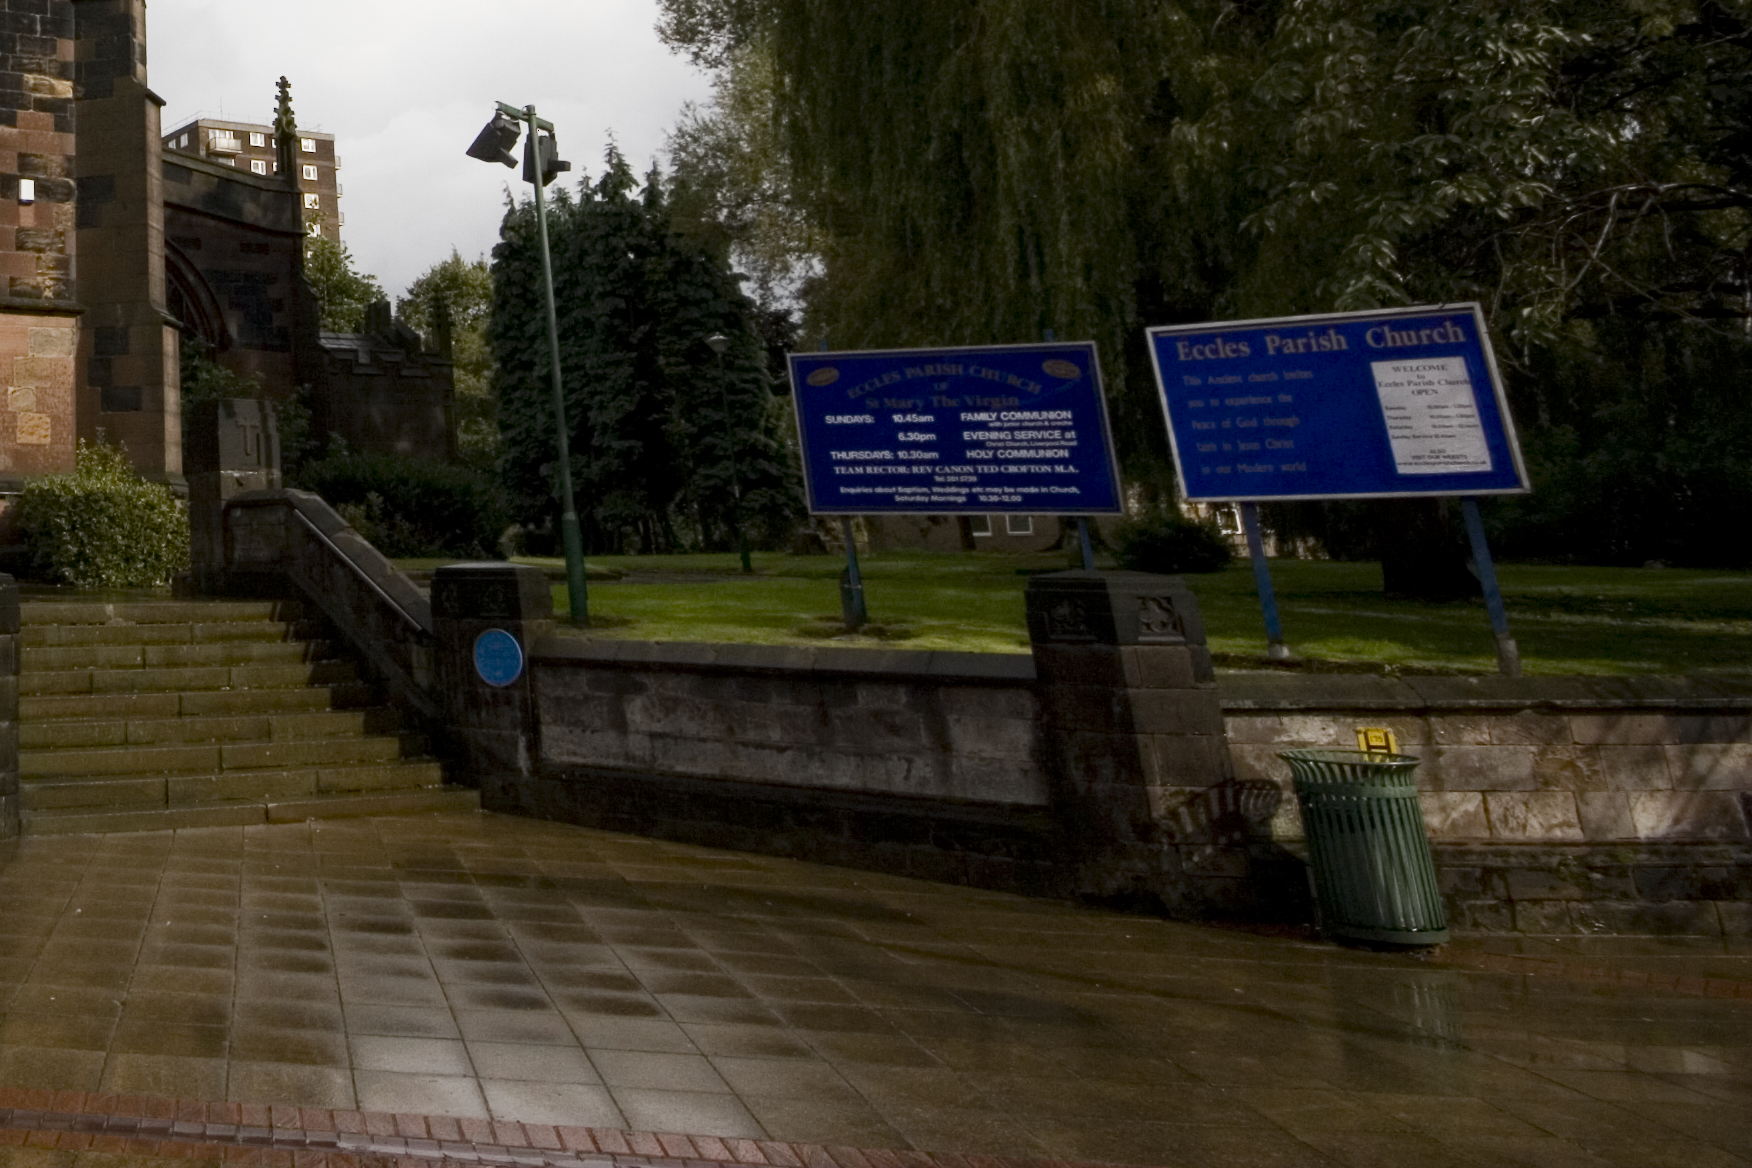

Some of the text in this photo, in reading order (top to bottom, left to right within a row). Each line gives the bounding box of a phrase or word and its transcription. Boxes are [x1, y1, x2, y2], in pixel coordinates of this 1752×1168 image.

[1176, 321, 1467, 361] Eccles Parish Church
[1392, 364, 1448, 373] WELCOME
[847, 363, 1042, 399] ECCLES PARISH CHURCH
[884, 397, 924, 411] Mary
[964, 394, 1019, 410] Virgin
[825, 410, 1072, 424] SUNDAYS: 10.45am FAMILY COMMUNION
[898, 430, 1076, 443] 6.30pm EVENING SERVICE at
[830, 449, 1069, 460] THURSDAYS: 10.30am HOLY COMMUNION
[833, 466, 864, 474] TEAM
[912, 465, 933, 474] REV
[935, 465, 974, 473] CANON
[976, 465, 999, 473] TED
[1000, 464, 1052, 473] CROFTON
[1054, 464, 1079, 473] M.A.
[895, 494, 929, 503] Saturday
[930, 494, 966, 503] Mornings
